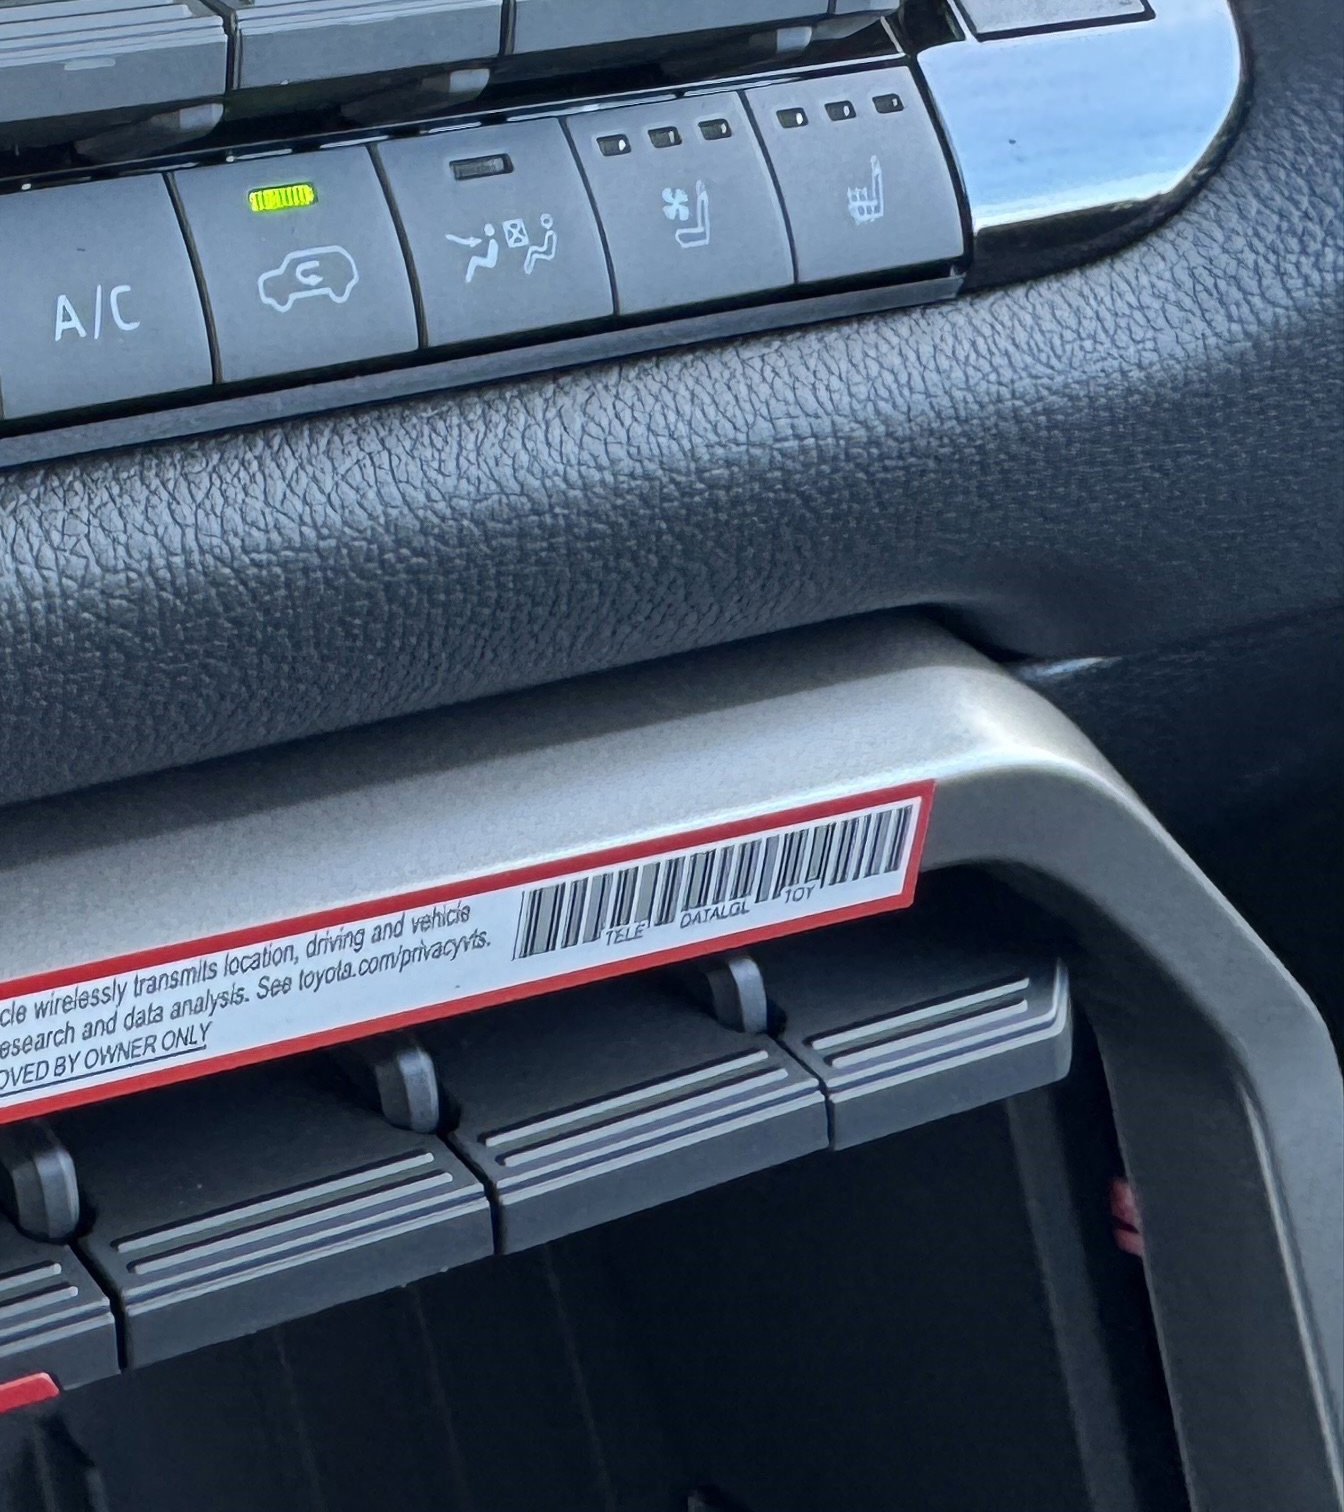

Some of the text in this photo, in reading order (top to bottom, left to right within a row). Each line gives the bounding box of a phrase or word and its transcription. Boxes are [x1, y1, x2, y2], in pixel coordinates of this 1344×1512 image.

[55, 285, 140, 341] A/C
[34, 978, 128, 1020] wirelessly
[133, 959, 218, 998] transmits
[223, 943, 299, 977] location,
[305, 927, 366, 959] driving
[370, 912, 406, 944] and
[411, 900, 471, 935] vehicle
[81, 1010, 118, 1041] and
[123, 1002, 164, 1031] data
[169, 982, 250, 1021] analysis.
[256, 975, 293, 1000] See
[53, 1050, 82, 1077] BY
[84, 1034, 158, 1070] OWNER
[161, 1020, 213, 1052] ONLY
